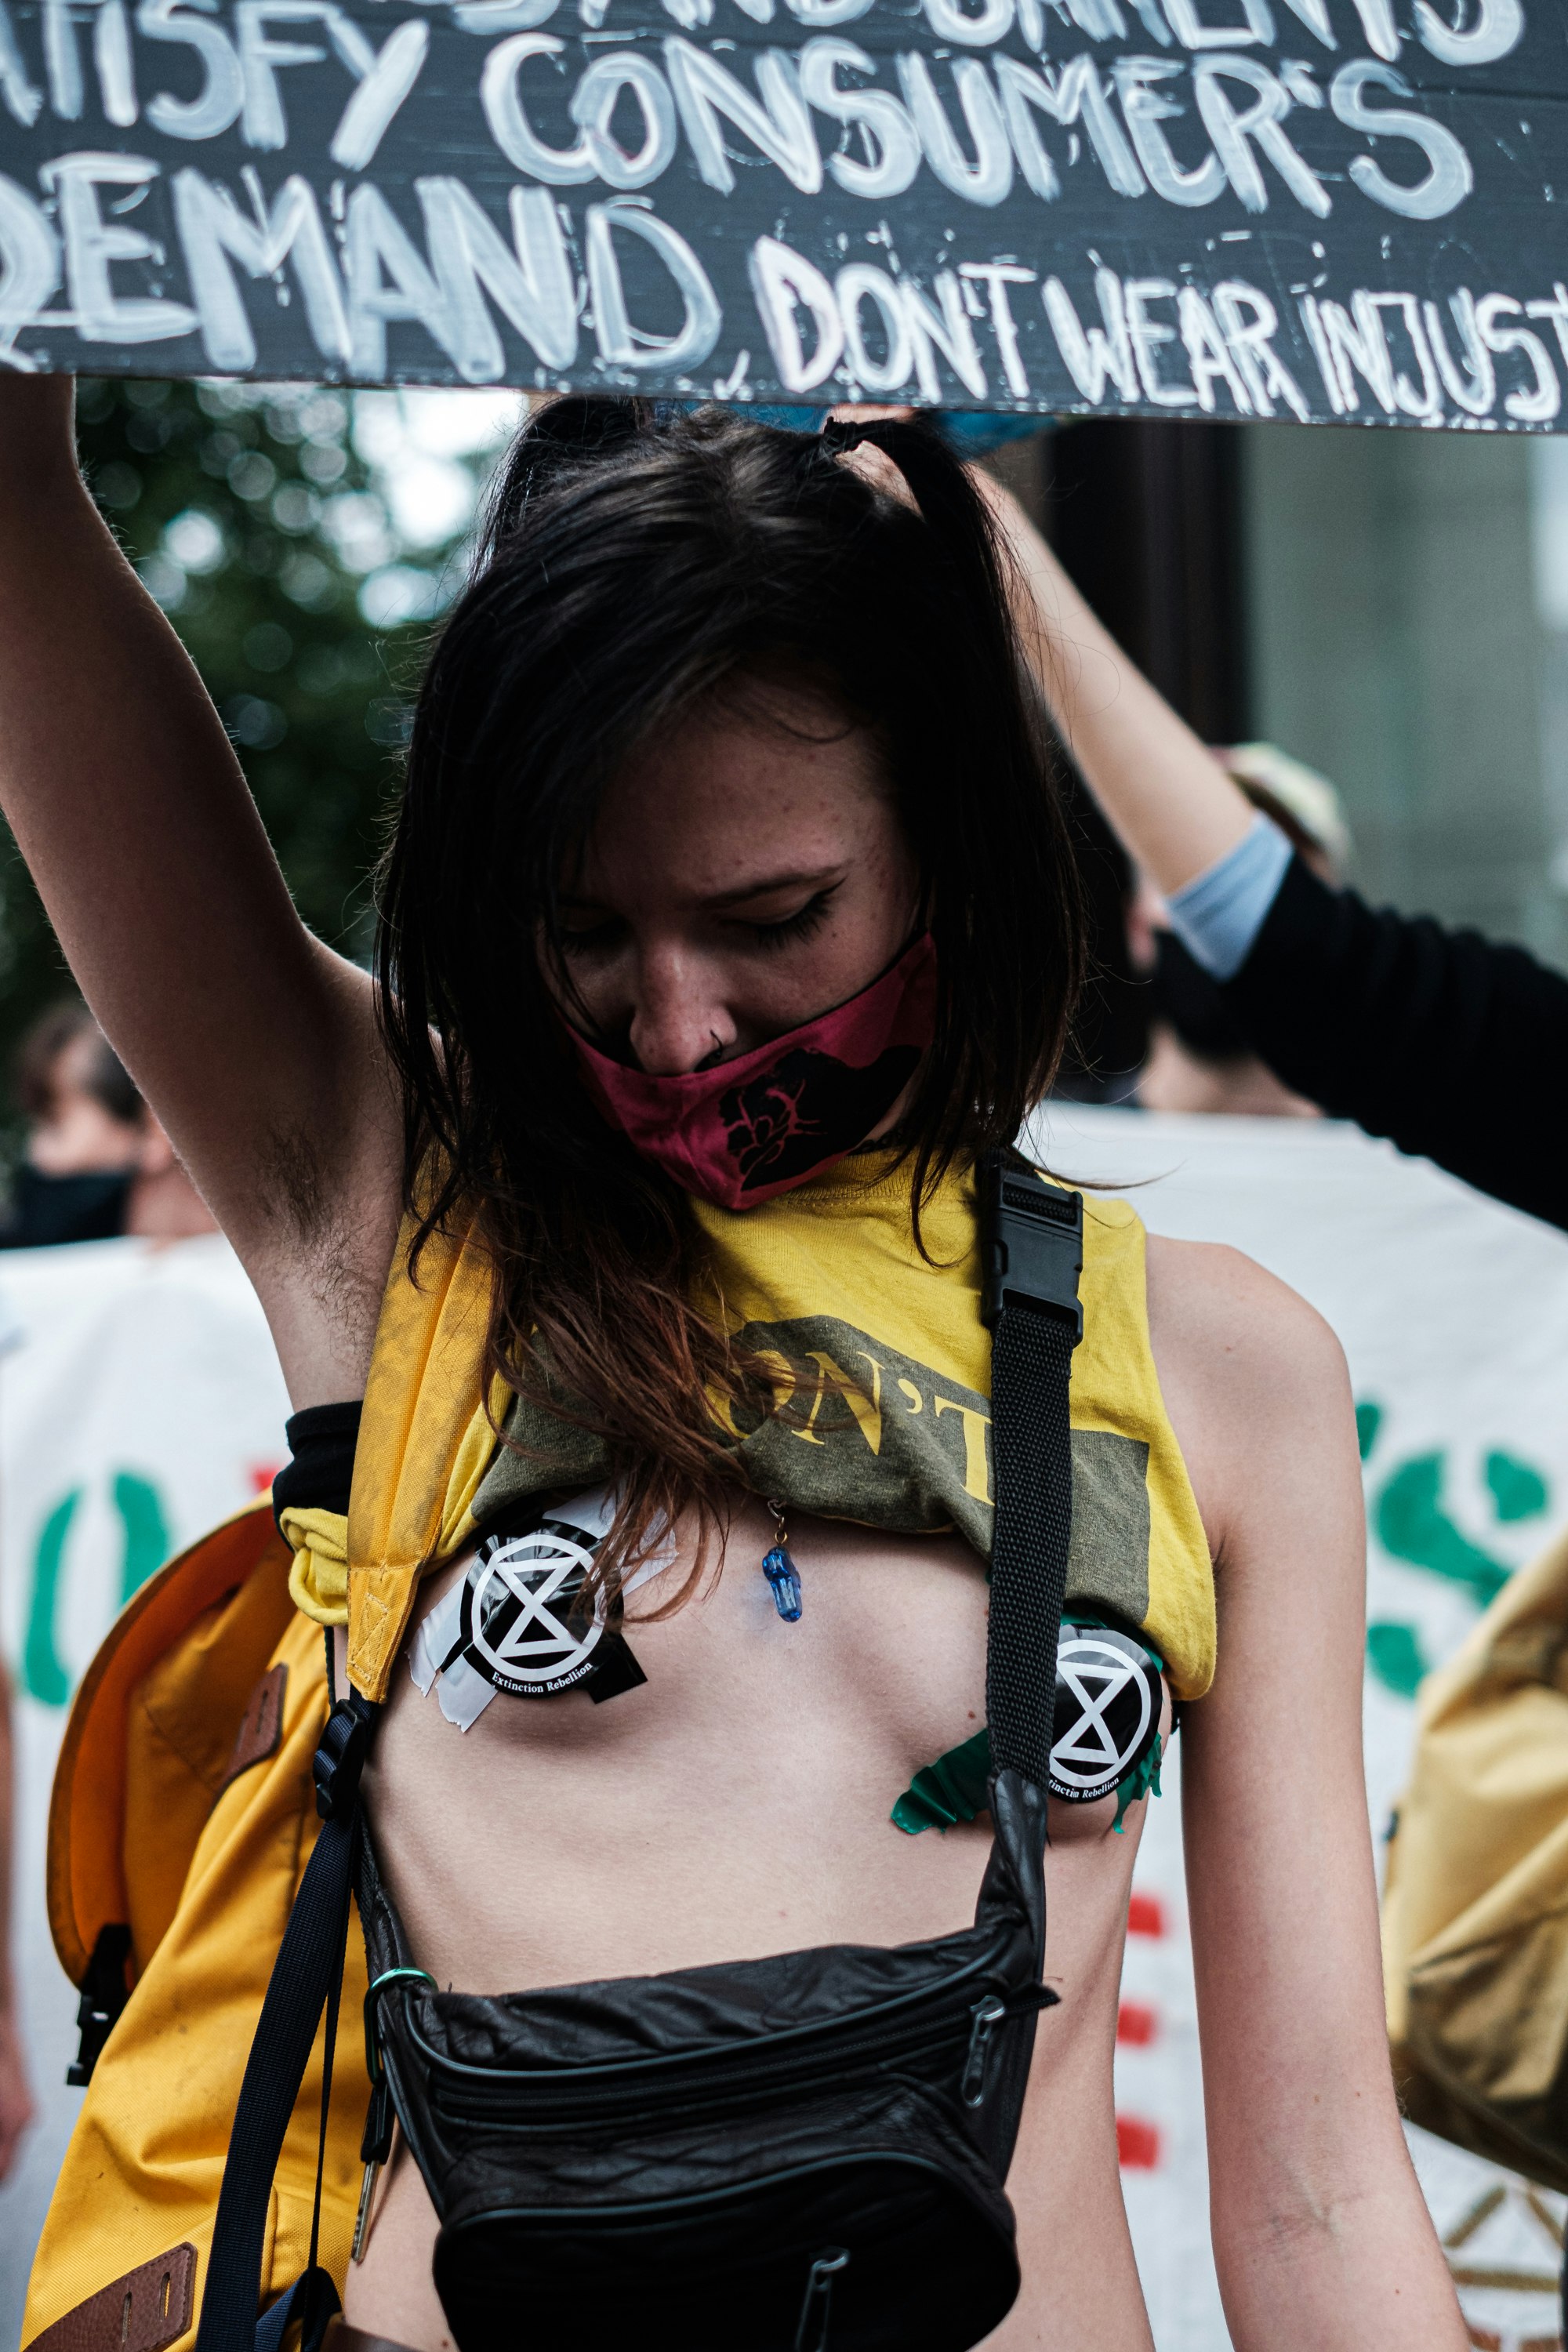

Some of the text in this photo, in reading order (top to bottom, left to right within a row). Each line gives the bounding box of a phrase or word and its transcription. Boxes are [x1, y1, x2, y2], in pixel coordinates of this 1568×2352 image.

[480, 33, 1474, 220] CONSUMER'S
[746, 234, 1039, 405] DON'T
[1041, 263, 1311, 423] WEAR
[491, 1662, 593, 1693] Extinction Rebellion
[1082, 1777, 1120, 1798] Rebellion
